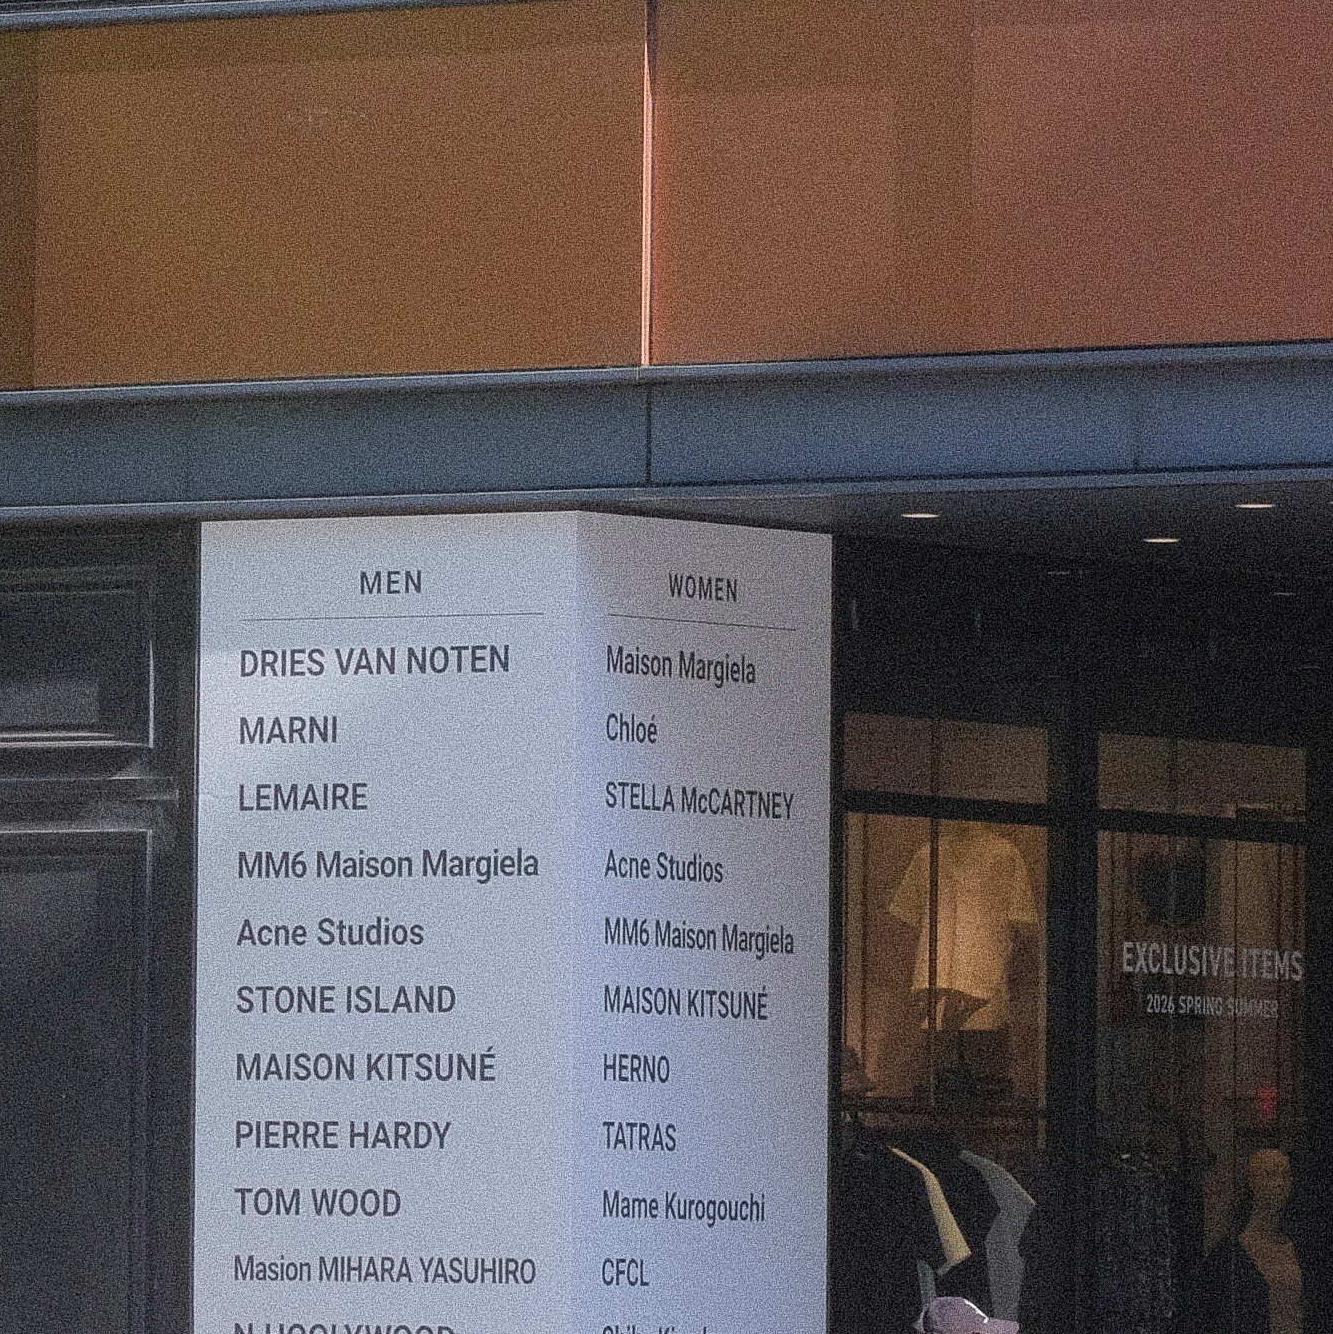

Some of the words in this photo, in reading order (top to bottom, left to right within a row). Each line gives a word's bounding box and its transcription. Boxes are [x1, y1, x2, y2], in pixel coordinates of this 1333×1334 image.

[360, 570, 422, 595] MEN
[669, 574, 737, 601] WOMEN
[240, 648, 325, 678] DRIES
[335, 647, 395, 675] VAN
[407, 644, 509, 674] NOTEN
[606, 645, 672, 676] Maison
[679, 651, 756, 689] Margiela
[239, 716, 338, 744] MARNI
[606, 713, 657, 744] Chloé
[239, 782, 368, 812] LEMAIRE
[606, 781, 675, 811] STELLA
[681, 786, 794, 819] McCARTNEY
[238, 851, 307, 879] MM6
[316, 850, 413, 878] Maison
[422, 847, 539, 885] Margiela
[605, 849, 650, 879] Acne
[657, 852, 723, 883] Studios
[236, 918, 307, 946] Acne
[317, 916, 424, 946] Studios
[604, 917, 649, 946] MM6
[655, 920, 716, 950] Maison
[722, 924, 794, 960] Margiela
[1122, 941, 1235, 978] EXCLUSIVE
[1241, 948, 1305, 982] ITEMS
[237, 985, 335, 1014] STONE
[346, 985, 456, 1014] ISLAND
[604, 985, 681, 1015] MAISON
[688, 985, 768, 1020] KITSUNÉ
[1145, 993, 1175, 1014] 2026
[1178, 995, 1224, 1018] SPRING
[1226, 998, 1279, 1020] SUMMER
[236, 1053, 355, 1081] MAISON
[366, 1046, 496, 1082] KITSUNÉ
[603, 1053, 670, 1084] HERNO
[235, 1120, 339, 1149] PIERRE
[349, 1121, 451, 1149] HARDY
[602, 1121, 676, 1152] TATRAS
[234, 1187, 300, 1216] TOM
[311, 1188, 401, 1217] WOOD
[603, 1190, 659, 1219] Mame
[665, 1193, 765, 1228] Kurogouchi
[318, 1256, 412, 1283] MIHARA
[419, 1257, 536, 1285] YASUHIRO
[602, 1258, 649, 1287] CFCL
